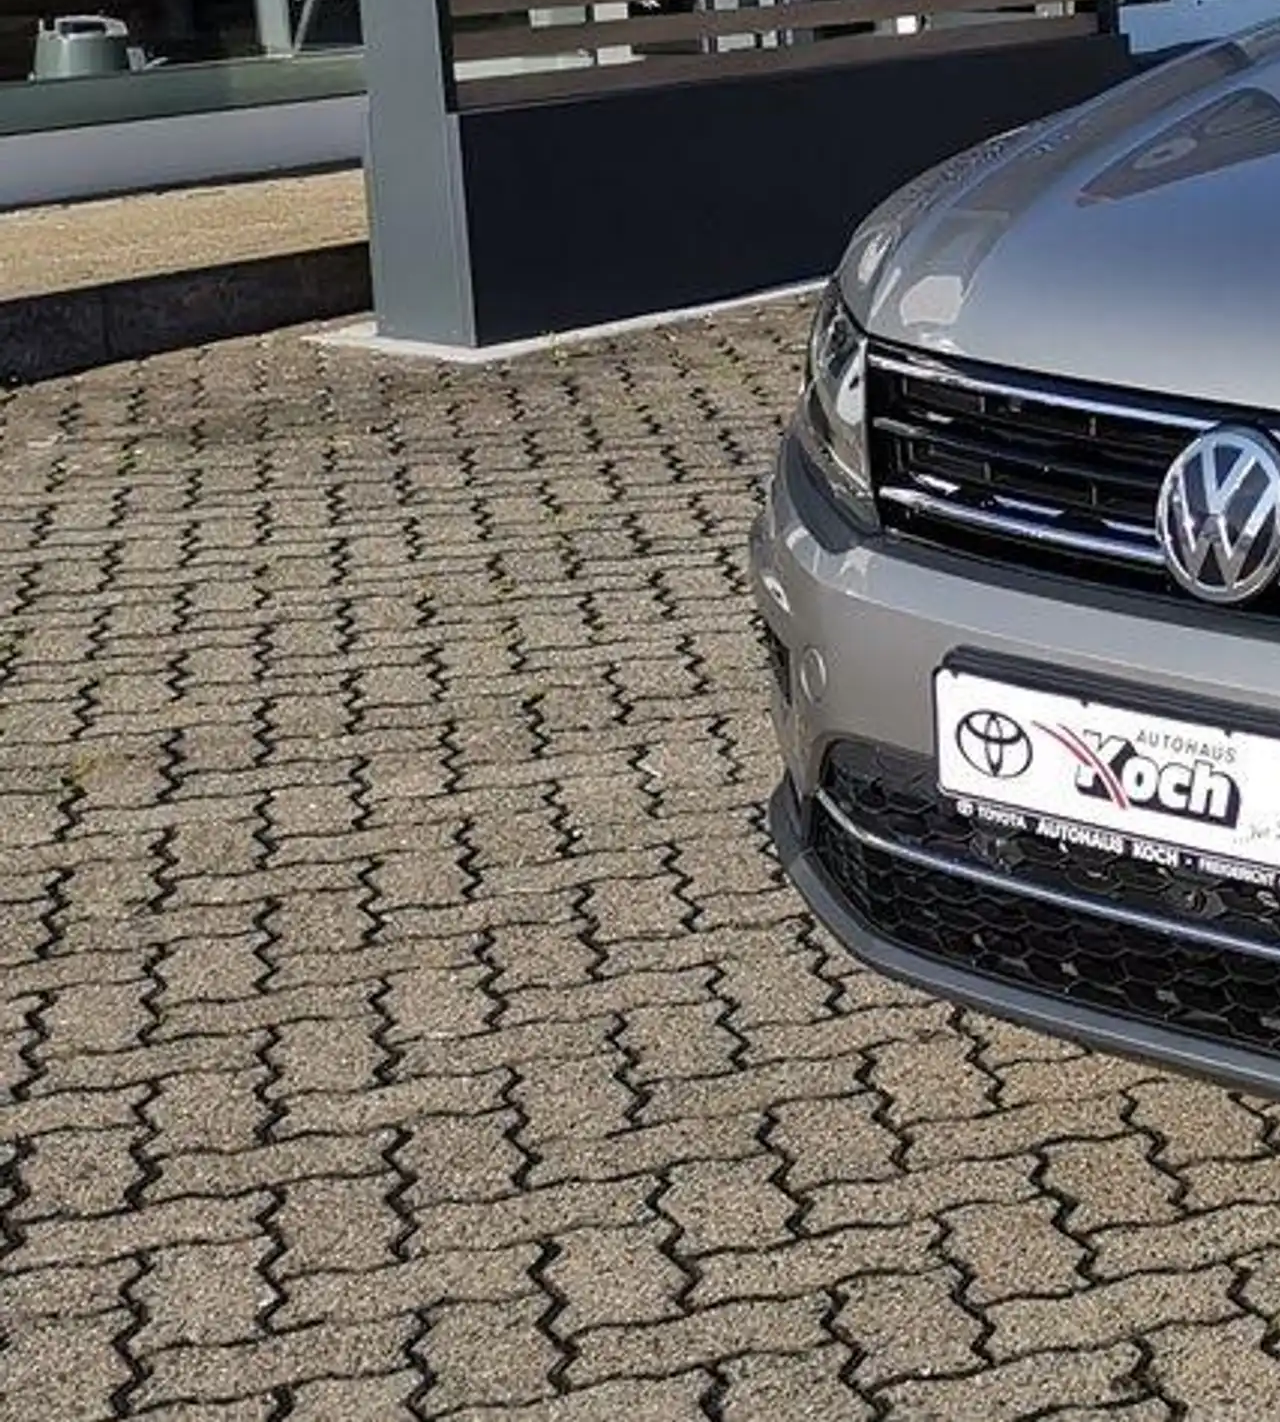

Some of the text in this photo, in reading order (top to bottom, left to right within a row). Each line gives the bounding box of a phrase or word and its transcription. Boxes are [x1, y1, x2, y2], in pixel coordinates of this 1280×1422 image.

[1136, 729, 1237, 764] AUTOHAUS
[1074, 728, 1241, 830] Koch
[977, 804, 1028, 830] TOYOTA
[1035, 817, 1125, 856] AUTOHAUS
[1131, 839, 1179, 868] KOCH
